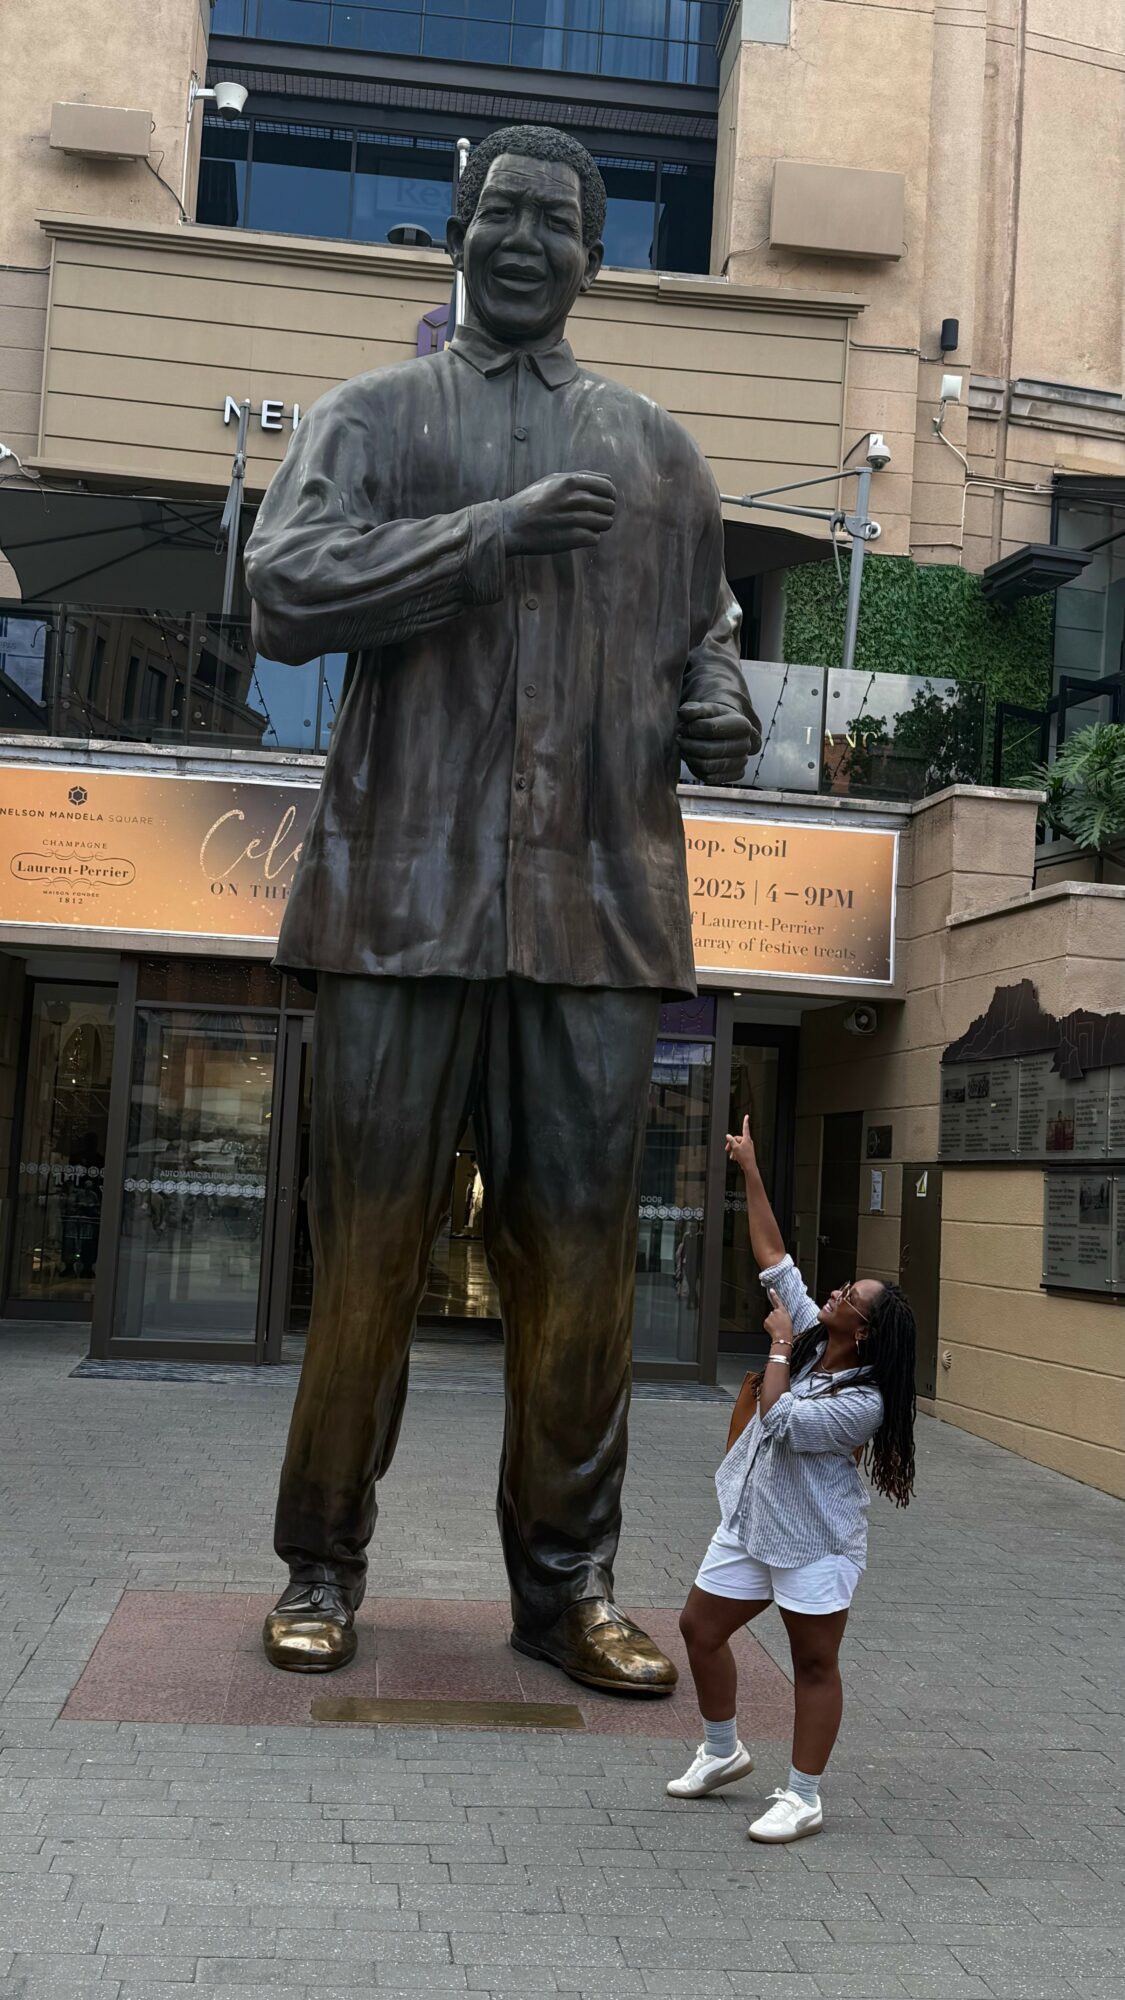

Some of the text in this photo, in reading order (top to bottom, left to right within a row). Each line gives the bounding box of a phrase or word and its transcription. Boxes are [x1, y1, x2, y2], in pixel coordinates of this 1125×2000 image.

[0, 807, 153, 825] NELSON MANDELA SQUARE
[42, 839, 108, 849] CHAMPAGNE
[733, 836, 787, 861] Spoil
[17, 860, 130, 878] Laurent-Perrier
[211, 882, 239, 897] ON
[692, 876, 746, 900] 2025
[702, 911, 825, 936] Laurent-Perrier
[694, 937, 857, 960] array of festive treats
[160, 1170, 202, 1180] AUTOMATIC
[640, 1195, 663, 1204] DOOR
